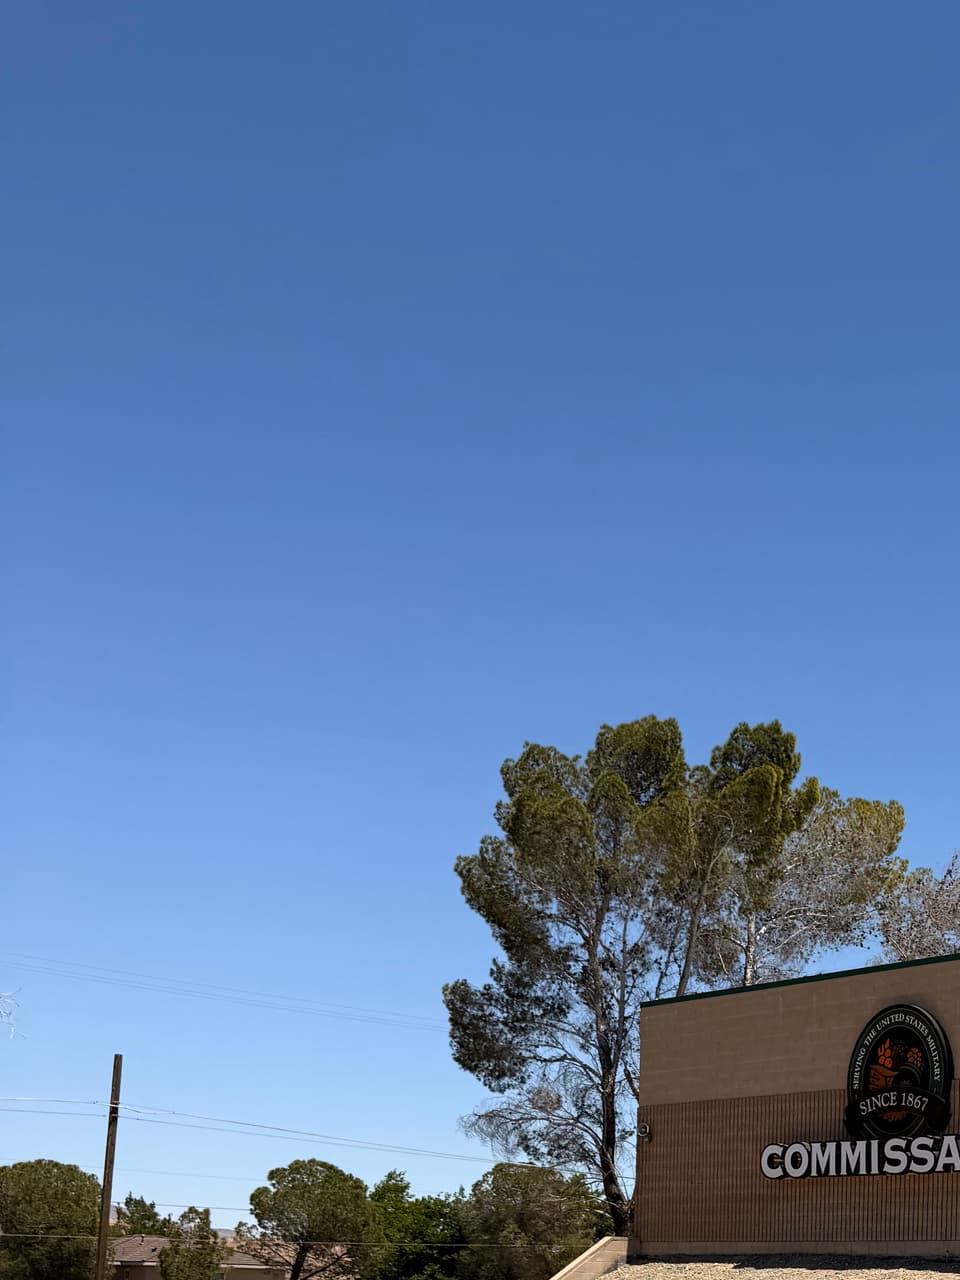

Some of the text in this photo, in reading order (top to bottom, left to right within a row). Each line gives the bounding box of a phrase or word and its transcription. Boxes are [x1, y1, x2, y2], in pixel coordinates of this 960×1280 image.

[853, 1013, 942, 1089] SERVING THE UNITED STATES MILITARY
[859, 1091, 929, 1116] SINCE 1867
